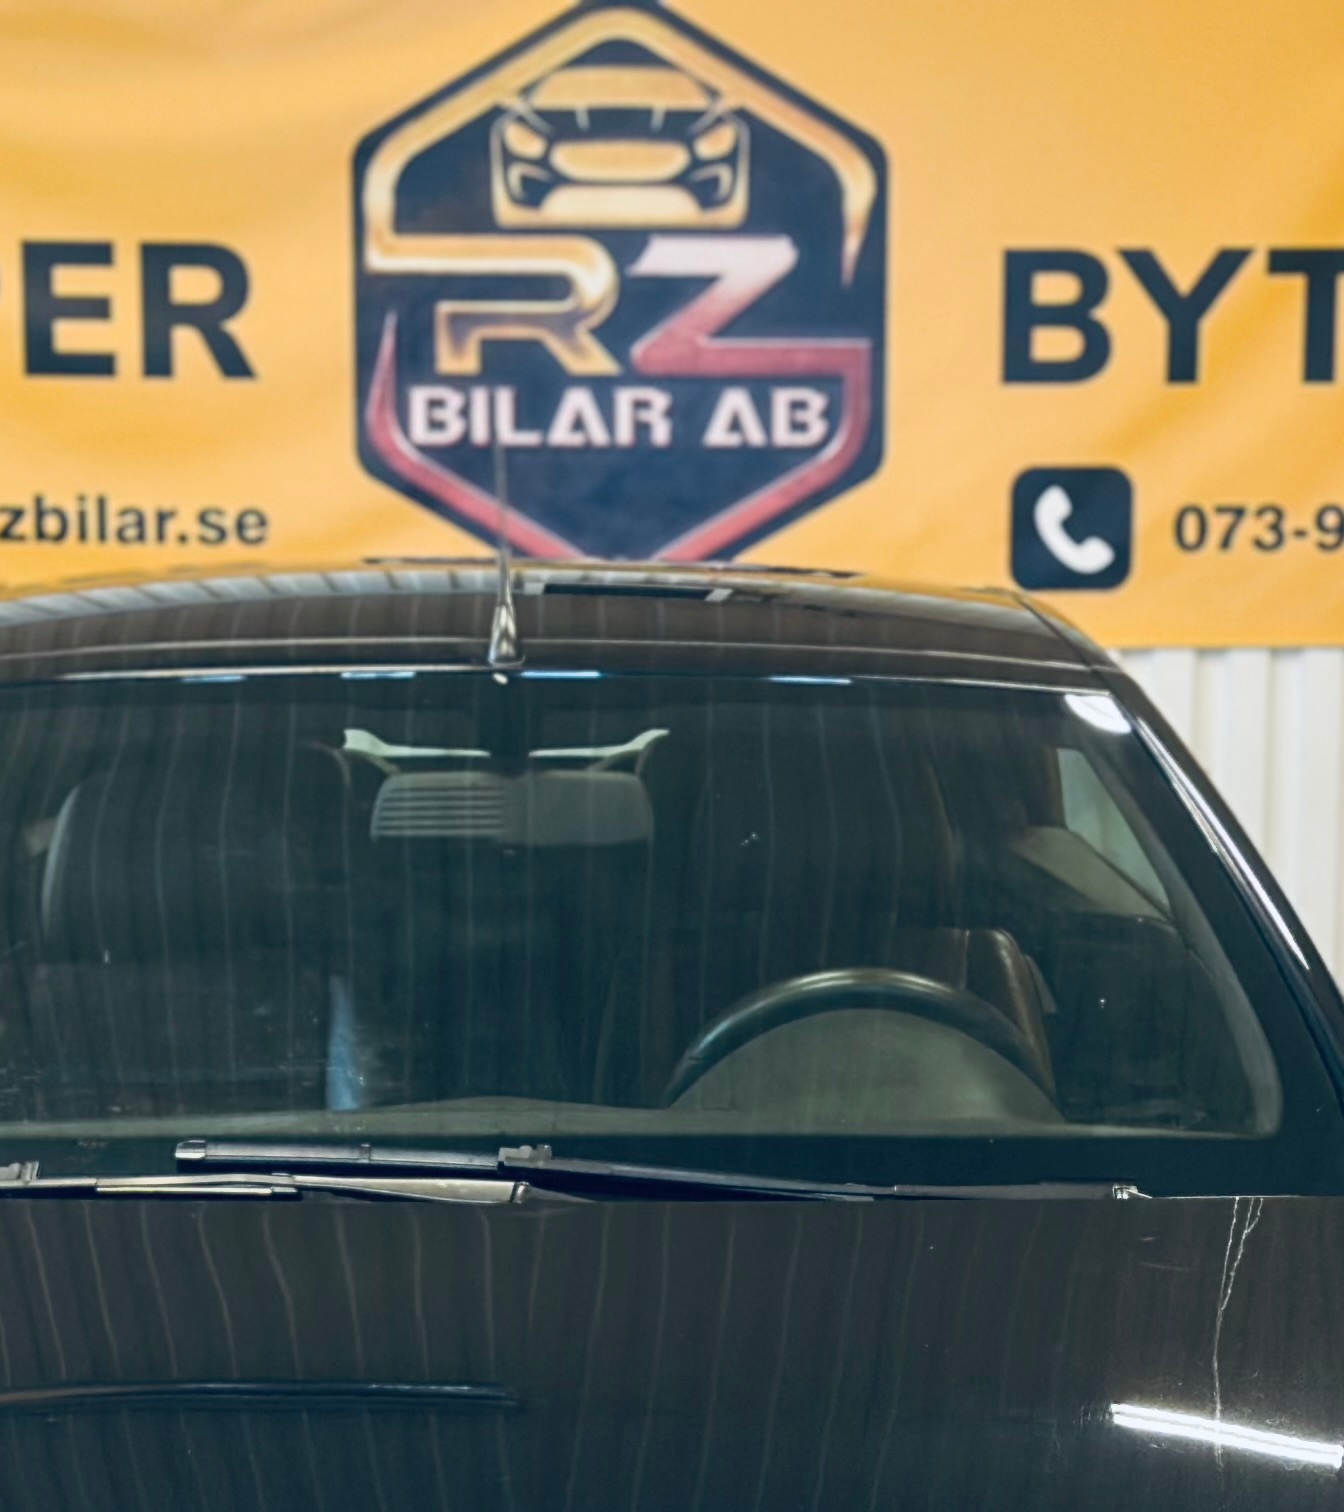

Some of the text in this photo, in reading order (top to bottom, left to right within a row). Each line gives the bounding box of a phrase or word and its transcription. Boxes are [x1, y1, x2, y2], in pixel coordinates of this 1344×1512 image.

[365, 234, 872, 375] RZ
[407, 385, 831, 447] BILAR AB
